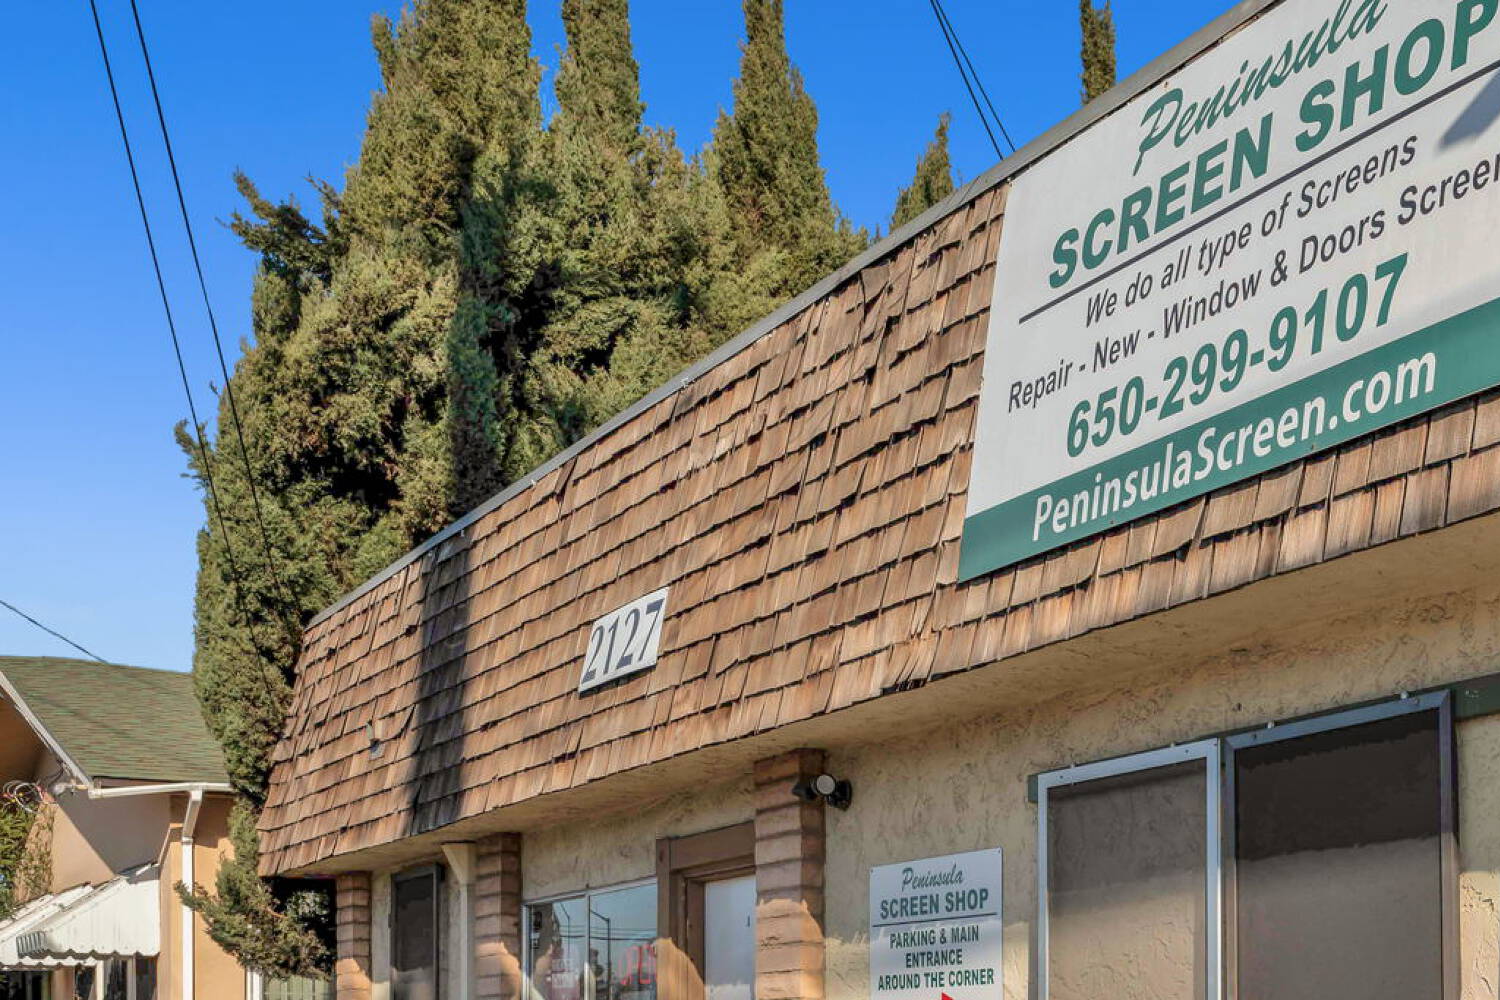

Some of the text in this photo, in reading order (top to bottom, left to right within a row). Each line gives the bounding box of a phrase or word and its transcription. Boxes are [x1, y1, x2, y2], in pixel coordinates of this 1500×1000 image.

[1049, 0, 1499, 288] SCREEN SHOP
[1133, 0, 1388, 176] Peninsula
[1086, 135, 1418, 327] We do all type of Screens
[1008, 358, 1073, 413] Repair
[1093, 329, 1140, 373] New
[1163, 268, 1262, 339] Window
[1270, 250, 1288, 287] &
[1299, 210, 1385, 274] Doors
[1067, 252, 1408, 457] 650-299-9107
[1032, 351, 1436, 541] PeninsulaScreen.com
[581, 598, 665, 684] 2127
[880, 888, 989, 919] SCREEN SHOP
[890, 925, 979, 949] PARKING & MAIN
[902, 863, 964, 892] Peninsula
[878, 968, 995, 991] AROUND THE CORNER
[905, 948, 963, 969] ENTRANCE
